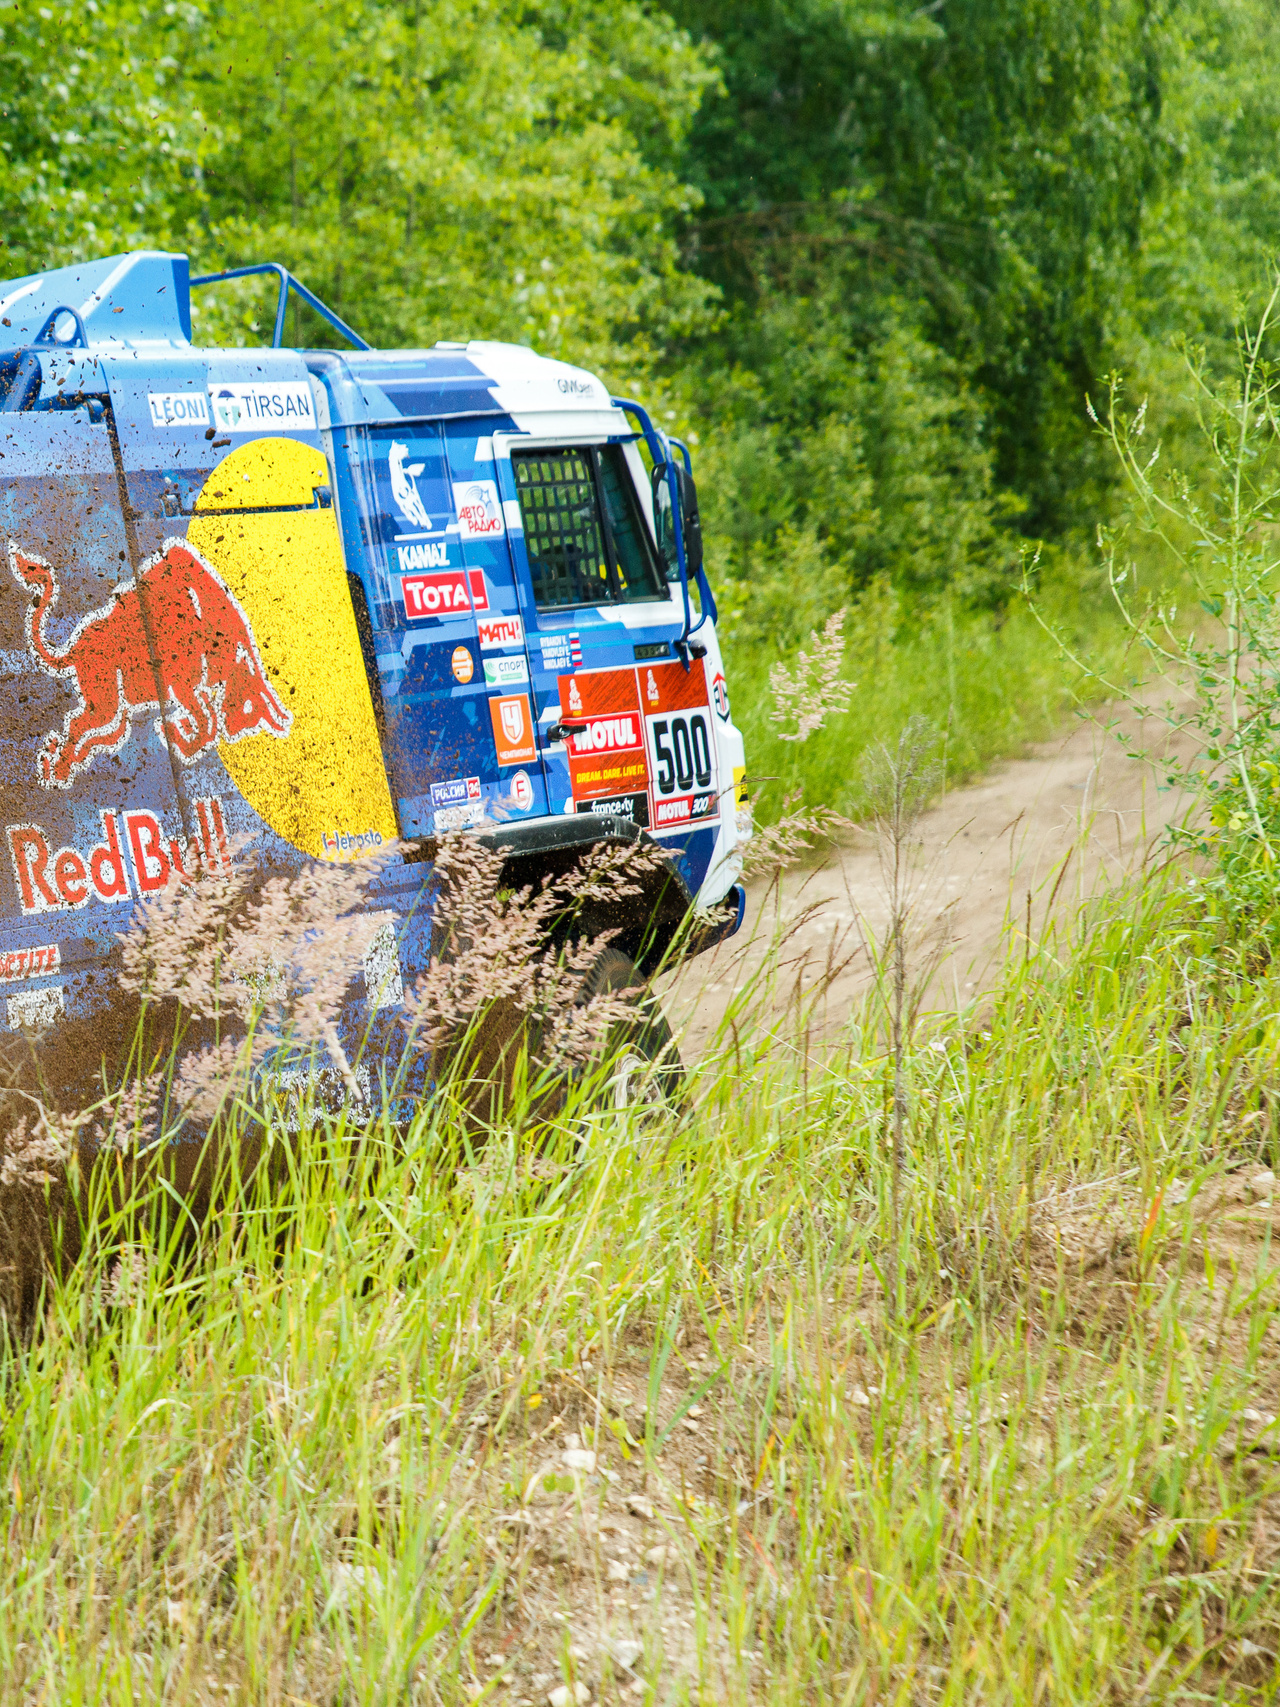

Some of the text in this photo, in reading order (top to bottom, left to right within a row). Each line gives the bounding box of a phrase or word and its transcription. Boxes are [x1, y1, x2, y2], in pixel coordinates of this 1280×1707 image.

[152, 398, 207, 420] LEONI
[458, 504, 485, 520] АВТО
[467, 518, 501, 534] РАДИО
[397, 542, 451, 571] KAMAZ
[405, 581, 485, 611] TOTAL
[498, 660, 525, 672] СПОРТ
[573, 717, 637, 752] MOTUL
[652, 714, 712, 795] 500
[435, 784, 466, 801] РОССИЯ
[657, 799, 691, 822] MOTUL
[6, 808, 131, 917] Red
